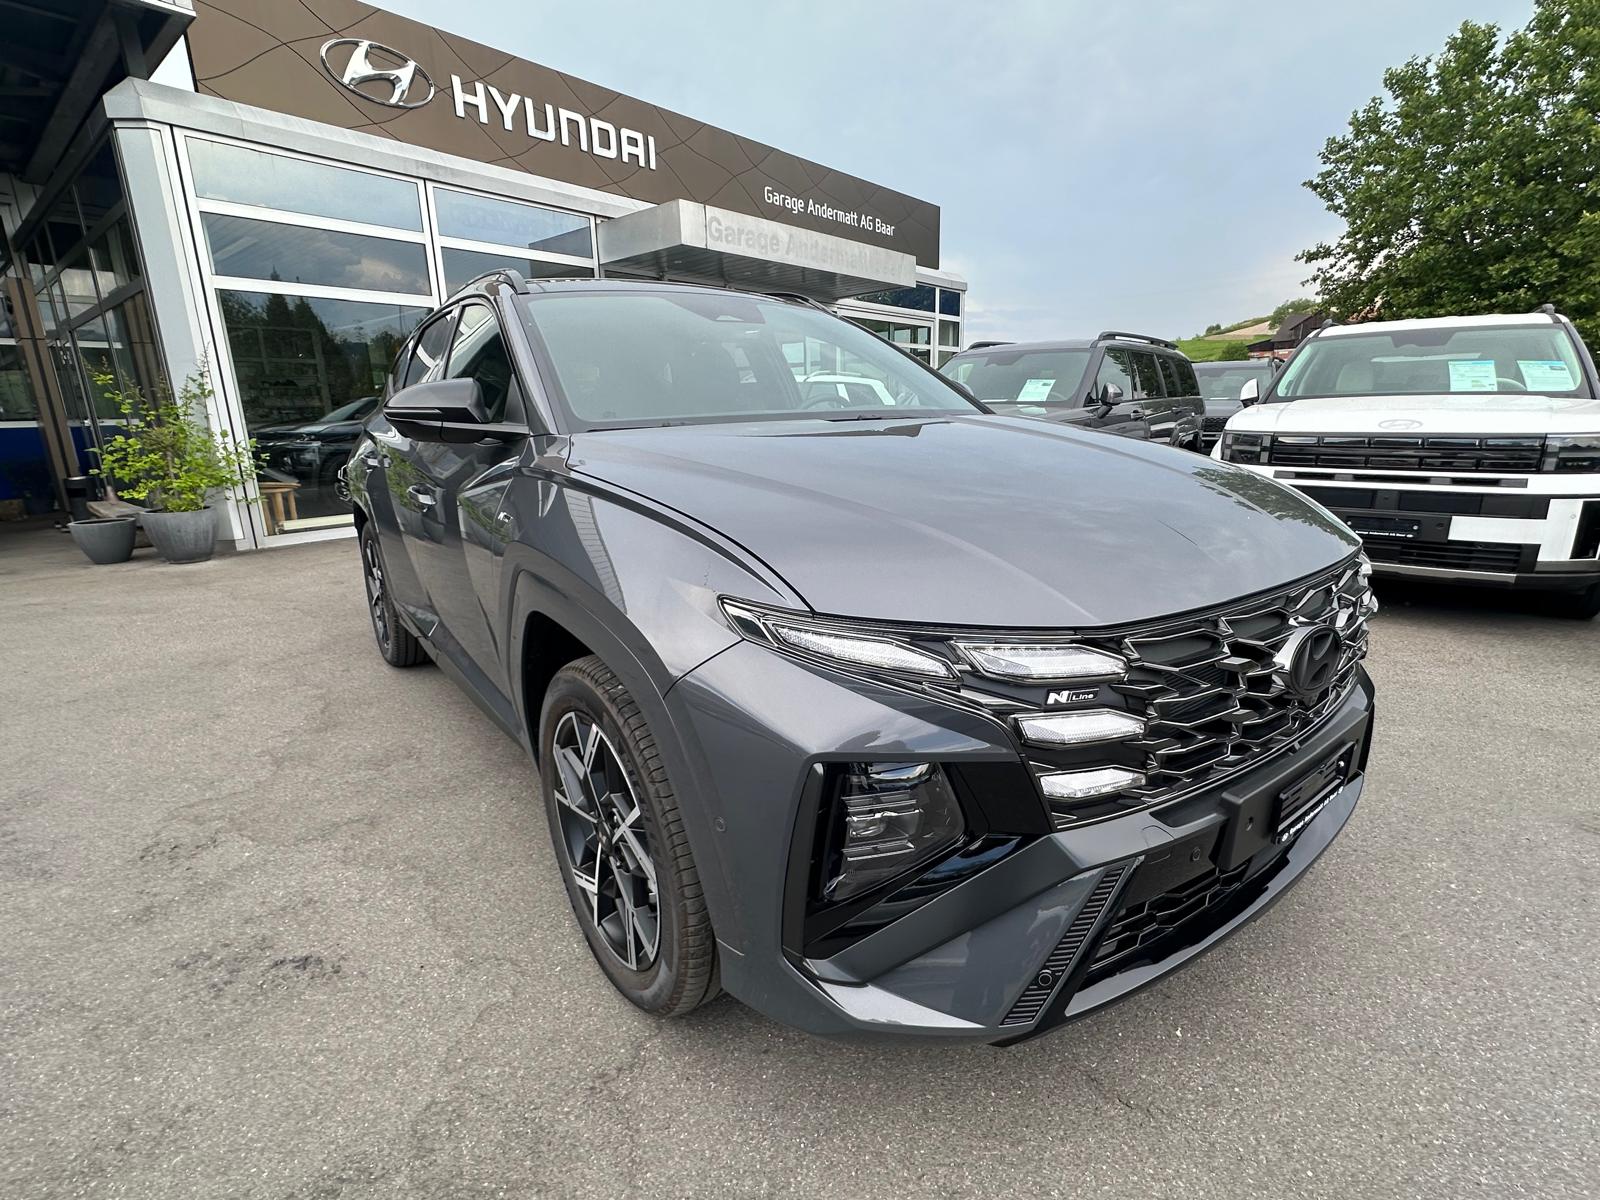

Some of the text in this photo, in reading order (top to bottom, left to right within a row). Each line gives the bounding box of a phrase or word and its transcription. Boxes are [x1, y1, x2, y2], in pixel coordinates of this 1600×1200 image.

[451, 74, 656, 170] HYUNDAI
[708, 215, 780, 255] Garage
[764, 186, 895, 236] Garage Andermatt AG Baar
